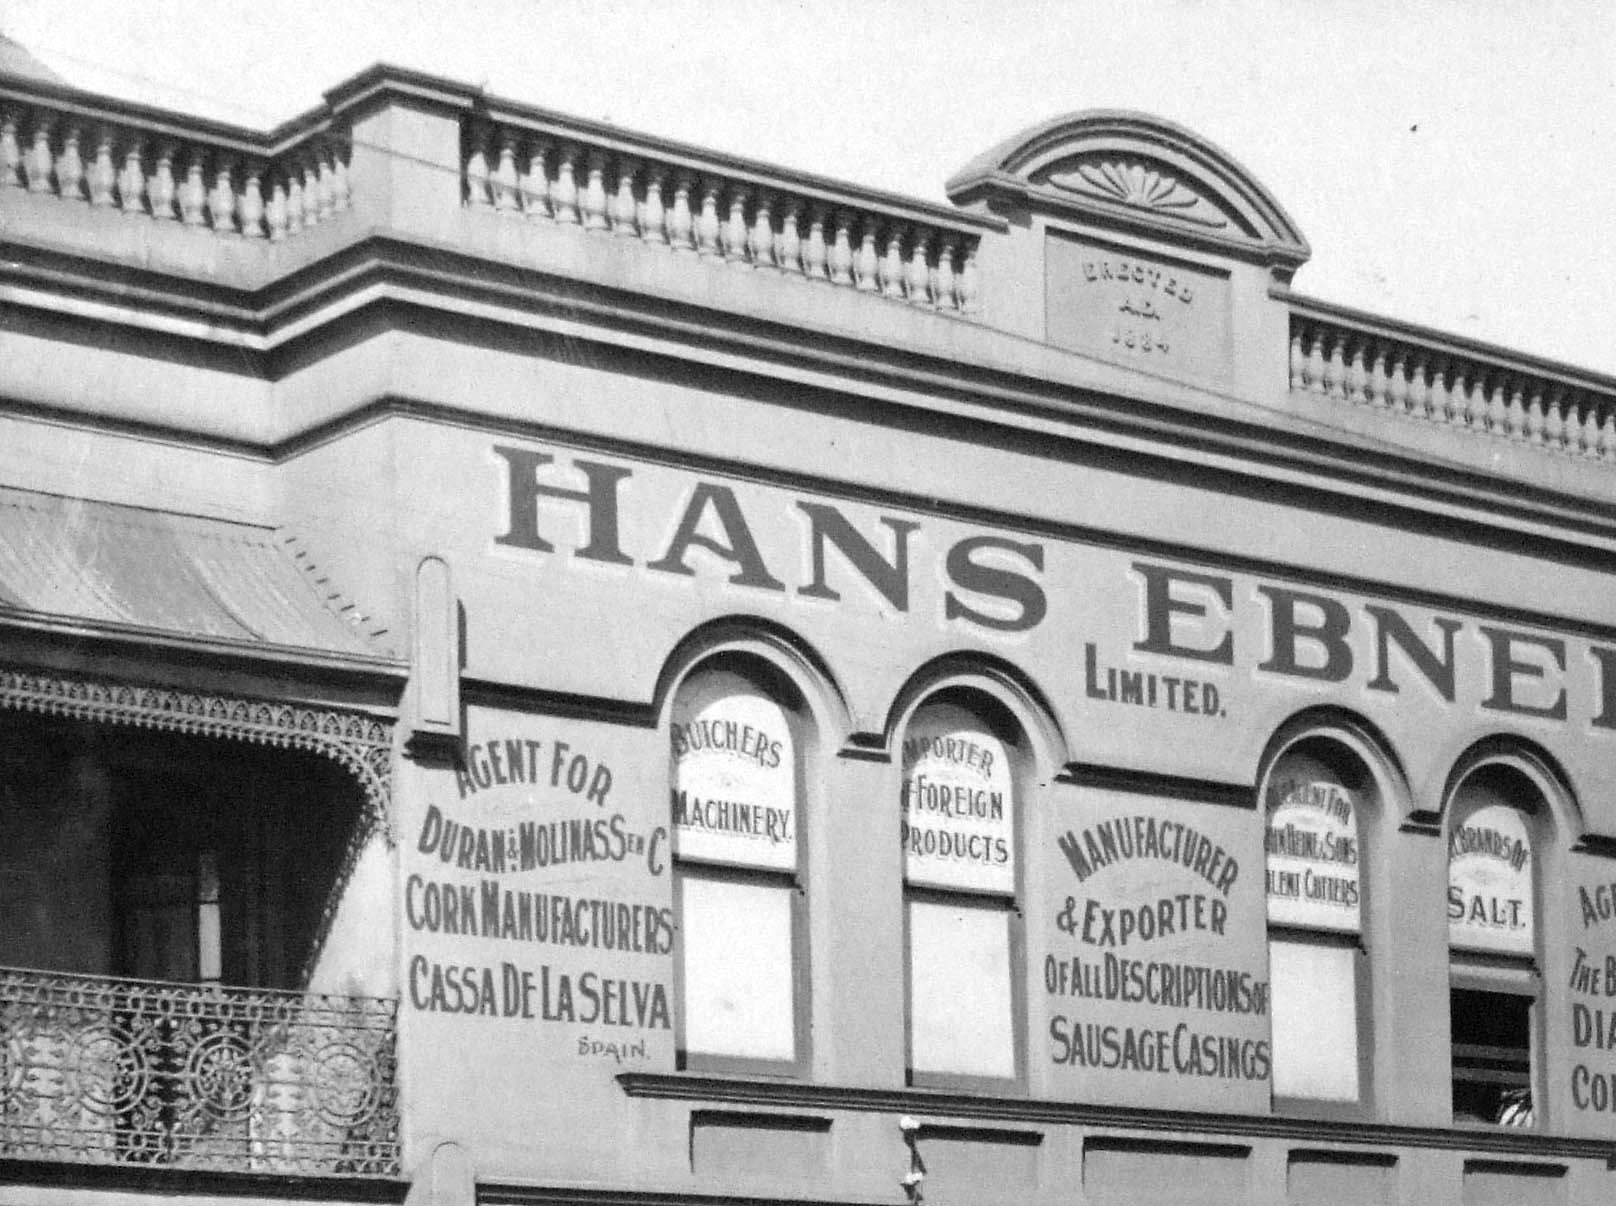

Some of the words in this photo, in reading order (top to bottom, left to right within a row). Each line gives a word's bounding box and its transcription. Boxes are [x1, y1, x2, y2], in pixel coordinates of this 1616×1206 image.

[492, 444, 1049, 632] HANS
[1086, 642, 1227, 717] LIMITED.
[455, 739, 540, 799] AGENT
[551, 741, 612, 807] FOR
[670, 720, 783, 768] BUTCHERS
[917, 774, 1003, 820] FOREIGN
[418, 804, 505, 873] DURAN
[902, 820, 1009, 863] PRODUCTS
[1057, 816, 1239, 897] MANUFACTURER
[406, 873, 477, 936] CORK
[481, 879, 674, 955] MANUFACTURERS
[1056, 895, 1078, 937] &
[1082, 894, 1228, 947] EXPORTER
[1305, 867, 1359, 908] CUTTERS
[410, 954, 497, 1017] CASSA
[501, 962, 537, 1018] DE
[541, 964, 575, 1022] LA
[578, 971, 672, 1029] SELVA
[1045, 954, 1069, 996] OF
[1071, 957, 1103, 999] ALL
[1104, 952, 1251, 1014] DESCRIPTIONS
[1569, 946, 1600, 996] THE
[1050, 1015, 1170, 1073] SAUSAGE
[1172, 1022, 1272, 1081] CASINGS
